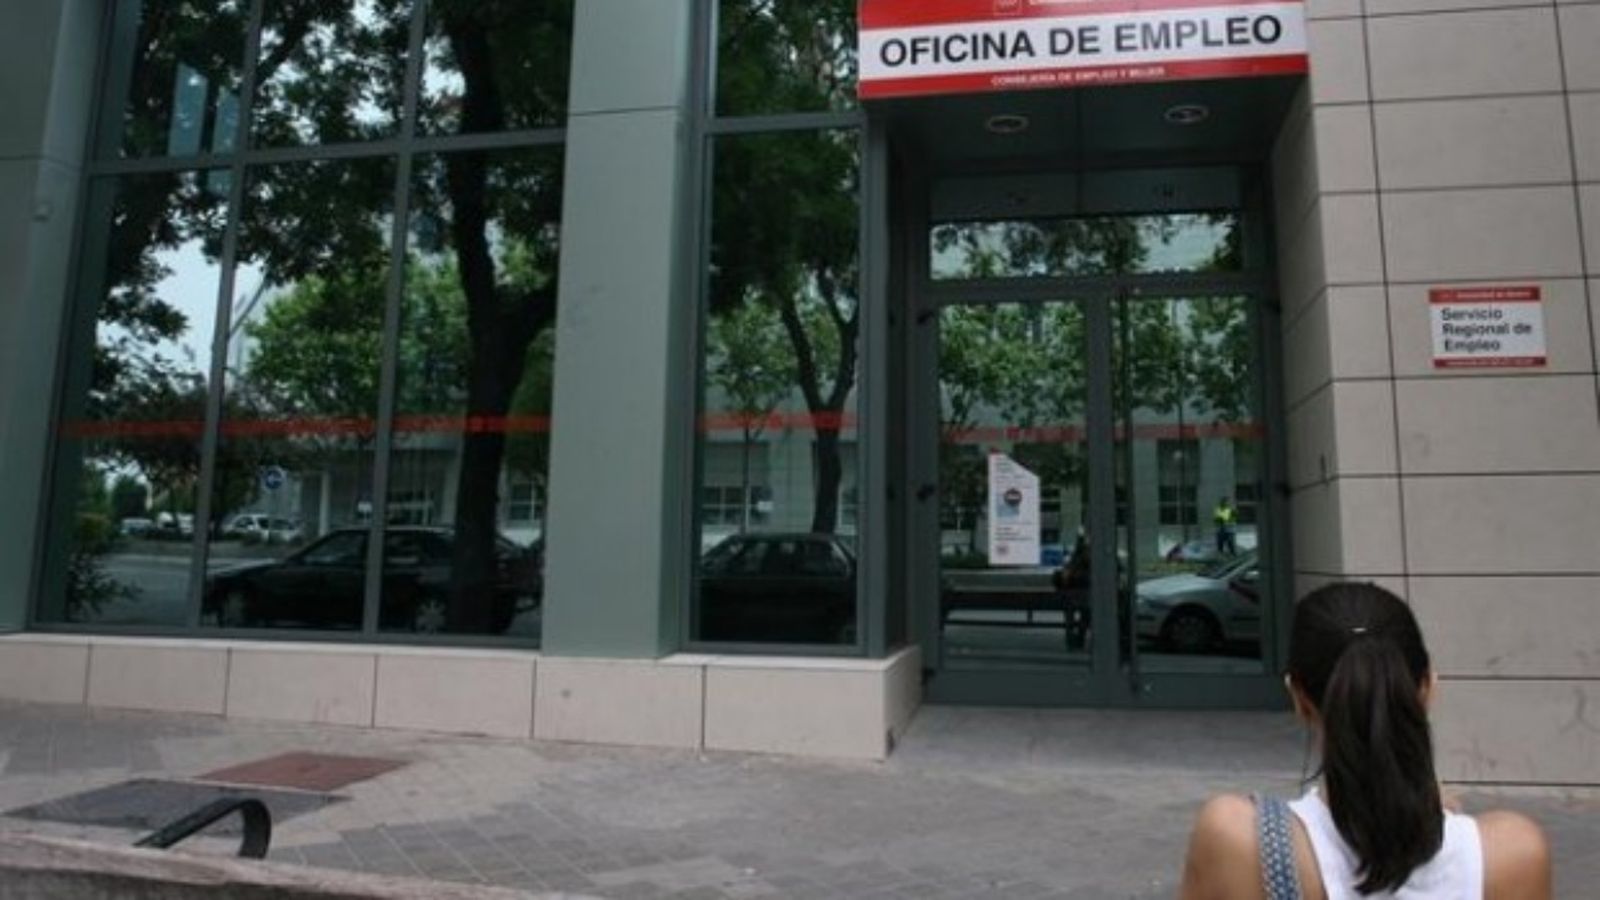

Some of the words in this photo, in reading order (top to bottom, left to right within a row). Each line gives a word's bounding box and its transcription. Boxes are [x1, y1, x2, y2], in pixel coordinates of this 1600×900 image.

[880, 29, 1035, 67] OFICINA
[1049, 27, 1101, 56] DE
[1115, 15, 1281, 52] EMPLEO
[1442, 306, 1502, 320] Servicio
[1442, 322, 1509, 337] Regional
[1513, 322, 1532, 334] de
[1444, 339, 1500, 352] Empleo
